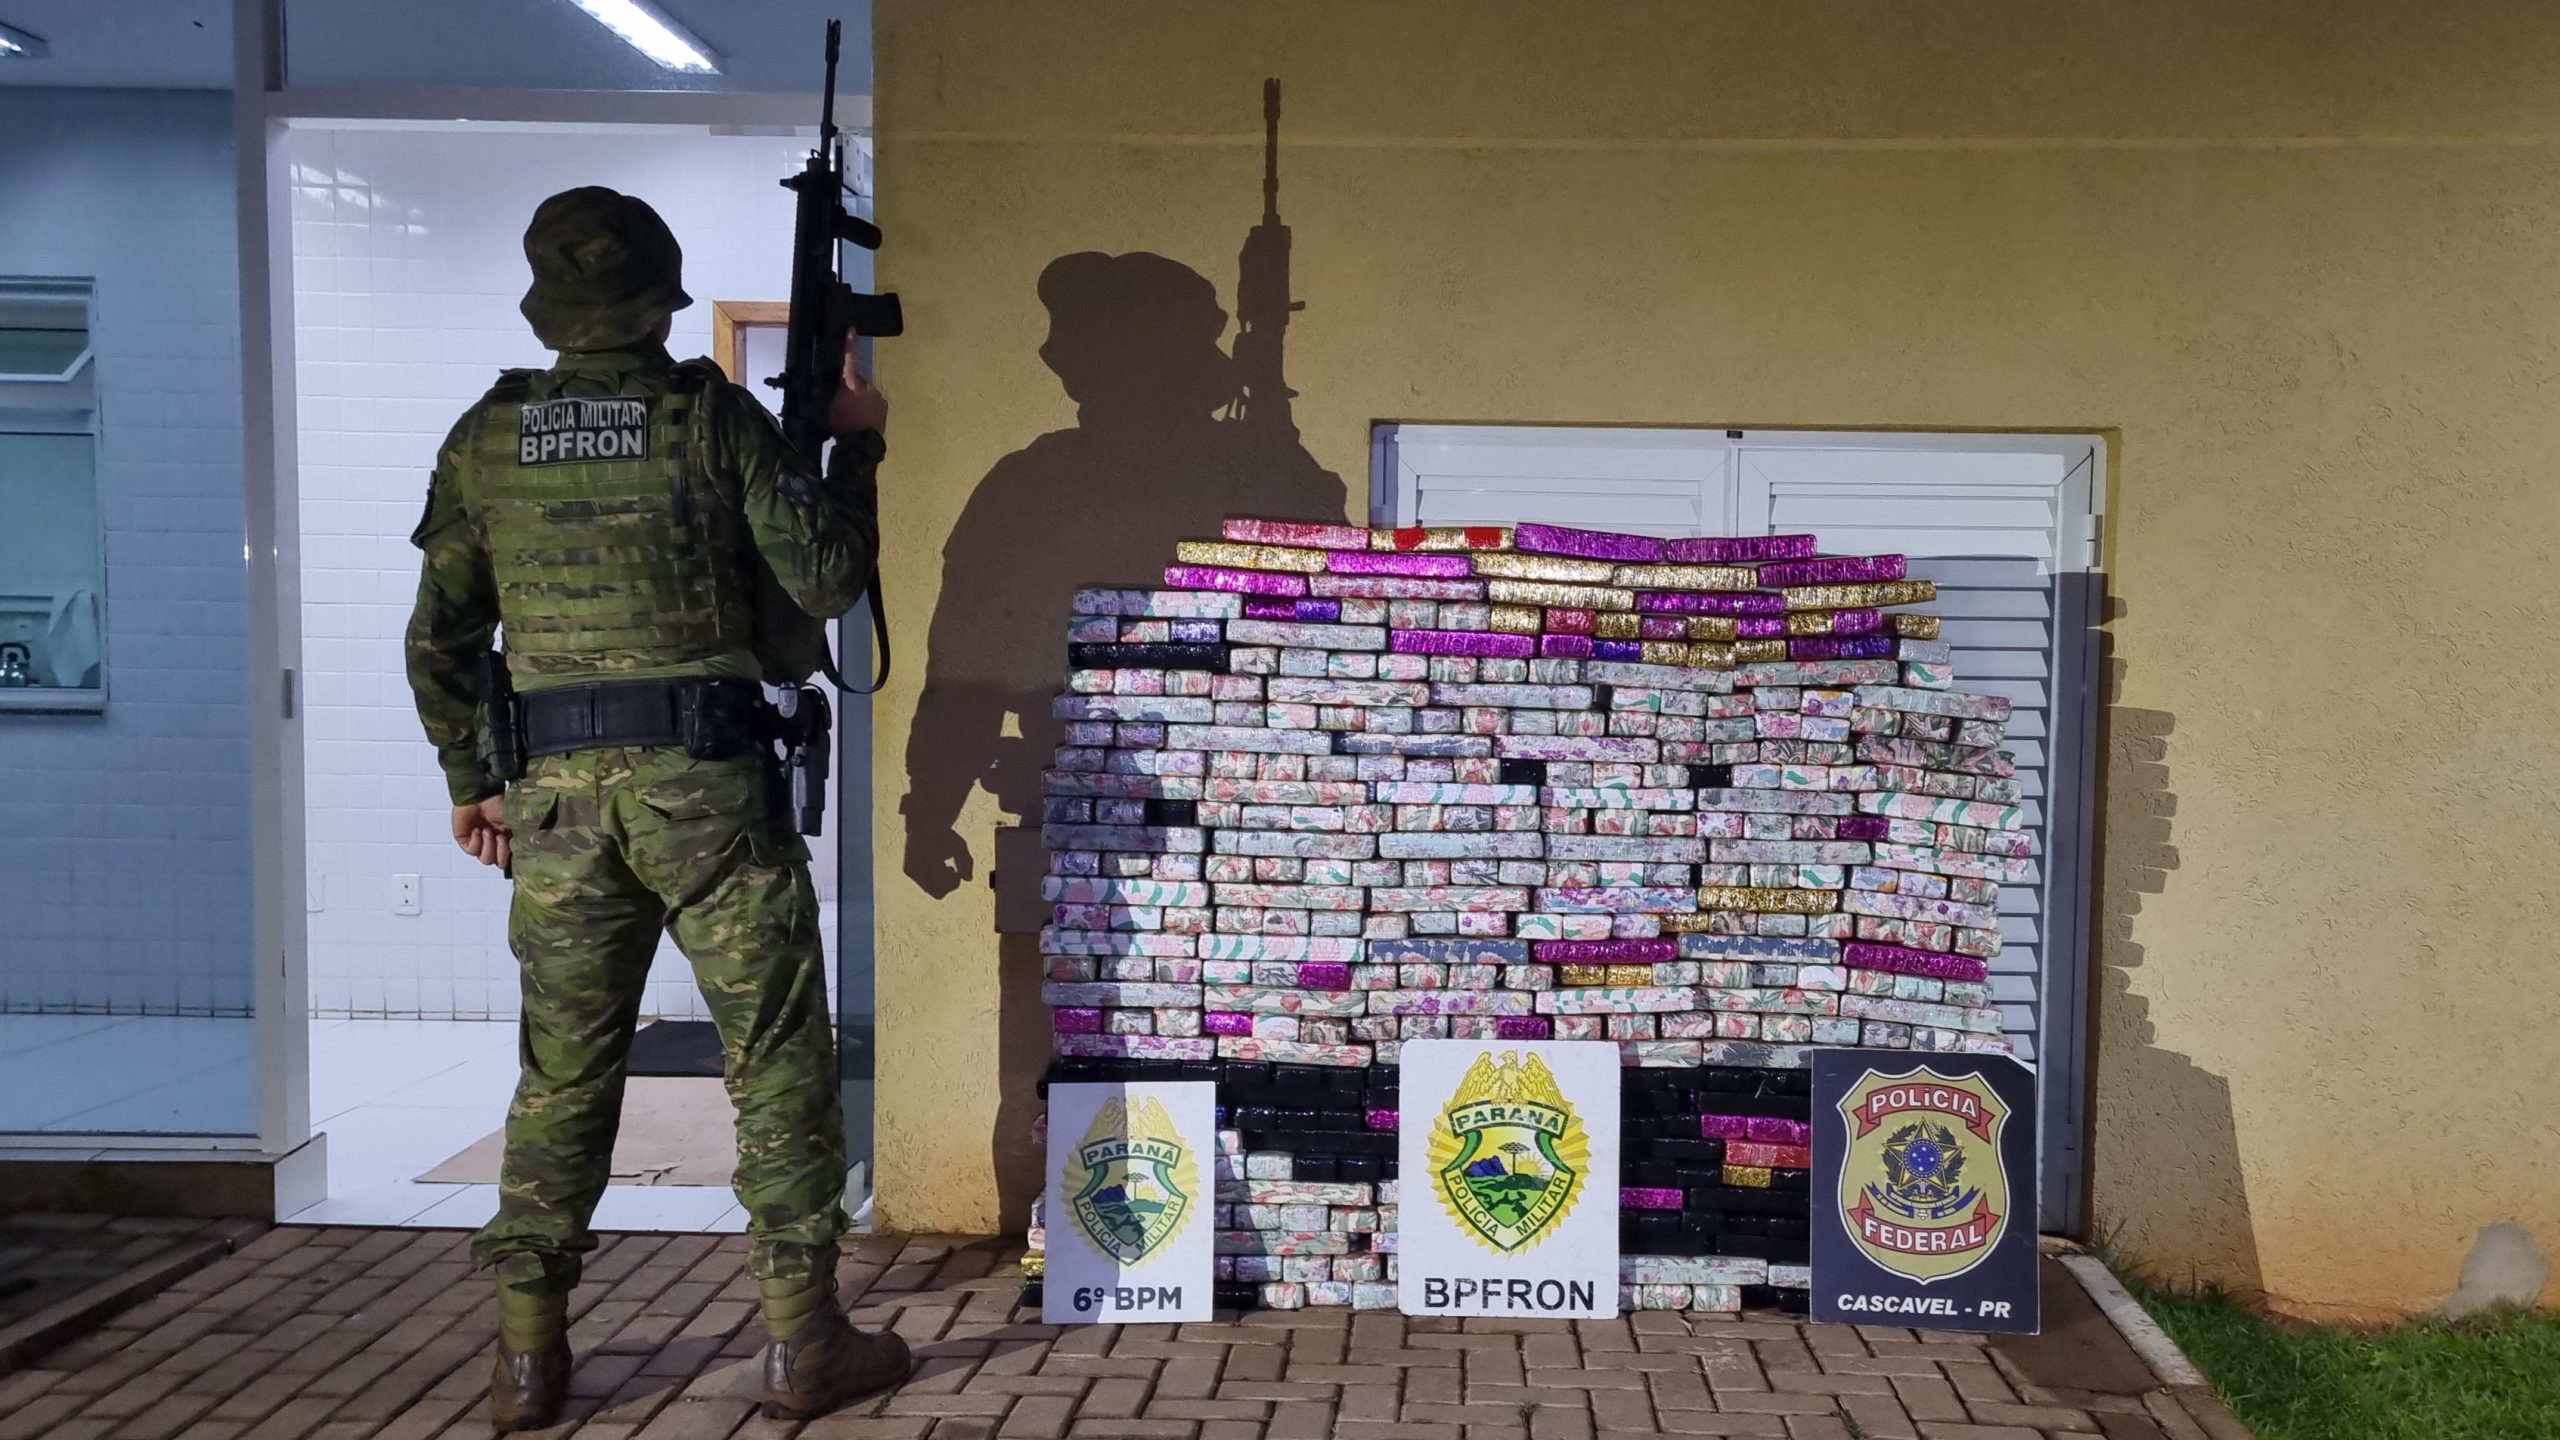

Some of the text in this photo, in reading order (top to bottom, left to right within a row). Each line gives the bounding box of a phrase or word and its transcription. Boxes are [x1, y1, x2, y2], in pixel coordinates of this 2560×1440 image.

[522, 401, 643, 434] POLICIA MILITAR
[521, 429, 643, 463] BPFRON
[1455, 1105, 1560, 1131] PARANÁ
[1086, 1141, 1175, 1164] PARANÁ
[1449, 1174, 1568, 1237] POLÍCIA MILITAR
[1135, 1200, 1181, 1253] MILITAR
[1864, 1217, 1983, 1251] FEDERAL
[1073, 1285, 1182, 1313] 6º BPM
[1424, 1276, 1595, 1312] BPFRON
[1837, 1293, 1959, 1317] CASCAVEL
[1978, 1300, 2012, 1319] PR
